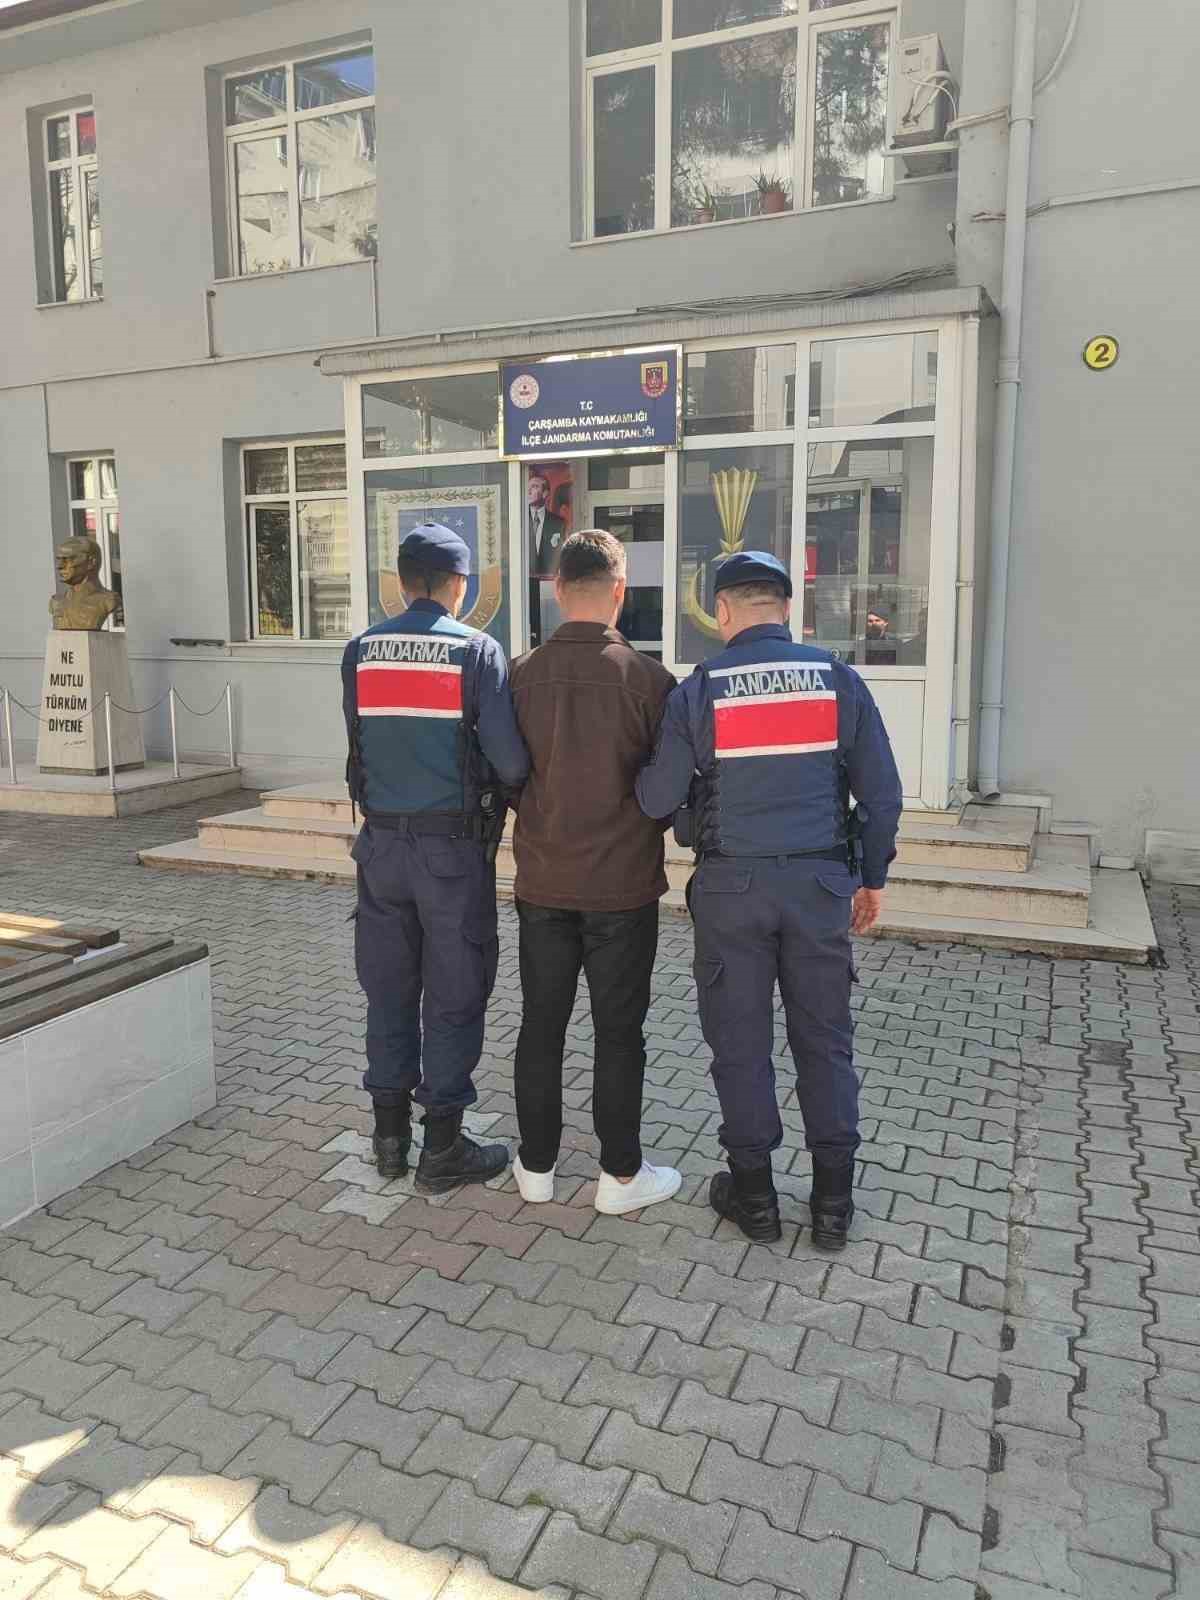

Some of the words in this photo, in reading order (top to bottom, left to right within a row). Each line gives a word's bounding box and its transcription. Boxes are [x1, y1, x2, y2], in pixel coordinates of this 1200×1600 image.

[1094, 343, 1109, 362] 2
[528, 416, 577, 431] ÇARŞAMBA
[579, 410, 648, 427] KAYMAKAMLIĞI
[521, 434, 541, 447] İLÇE
[543, 430, 592, 445] JANDARMA
[593, 425, 655, 441] KOMUTANLIĞI
[61, 651, 74, 664] NE
[363, 640, 450, 663] JANDARMA
[50, 673, 84, 687] MUTLU
[724, 670, 826, 697] JANDARMA
[46, 694, 87, 710] TÜRKÜM
[48, 716, 83, 733] DİYENE
